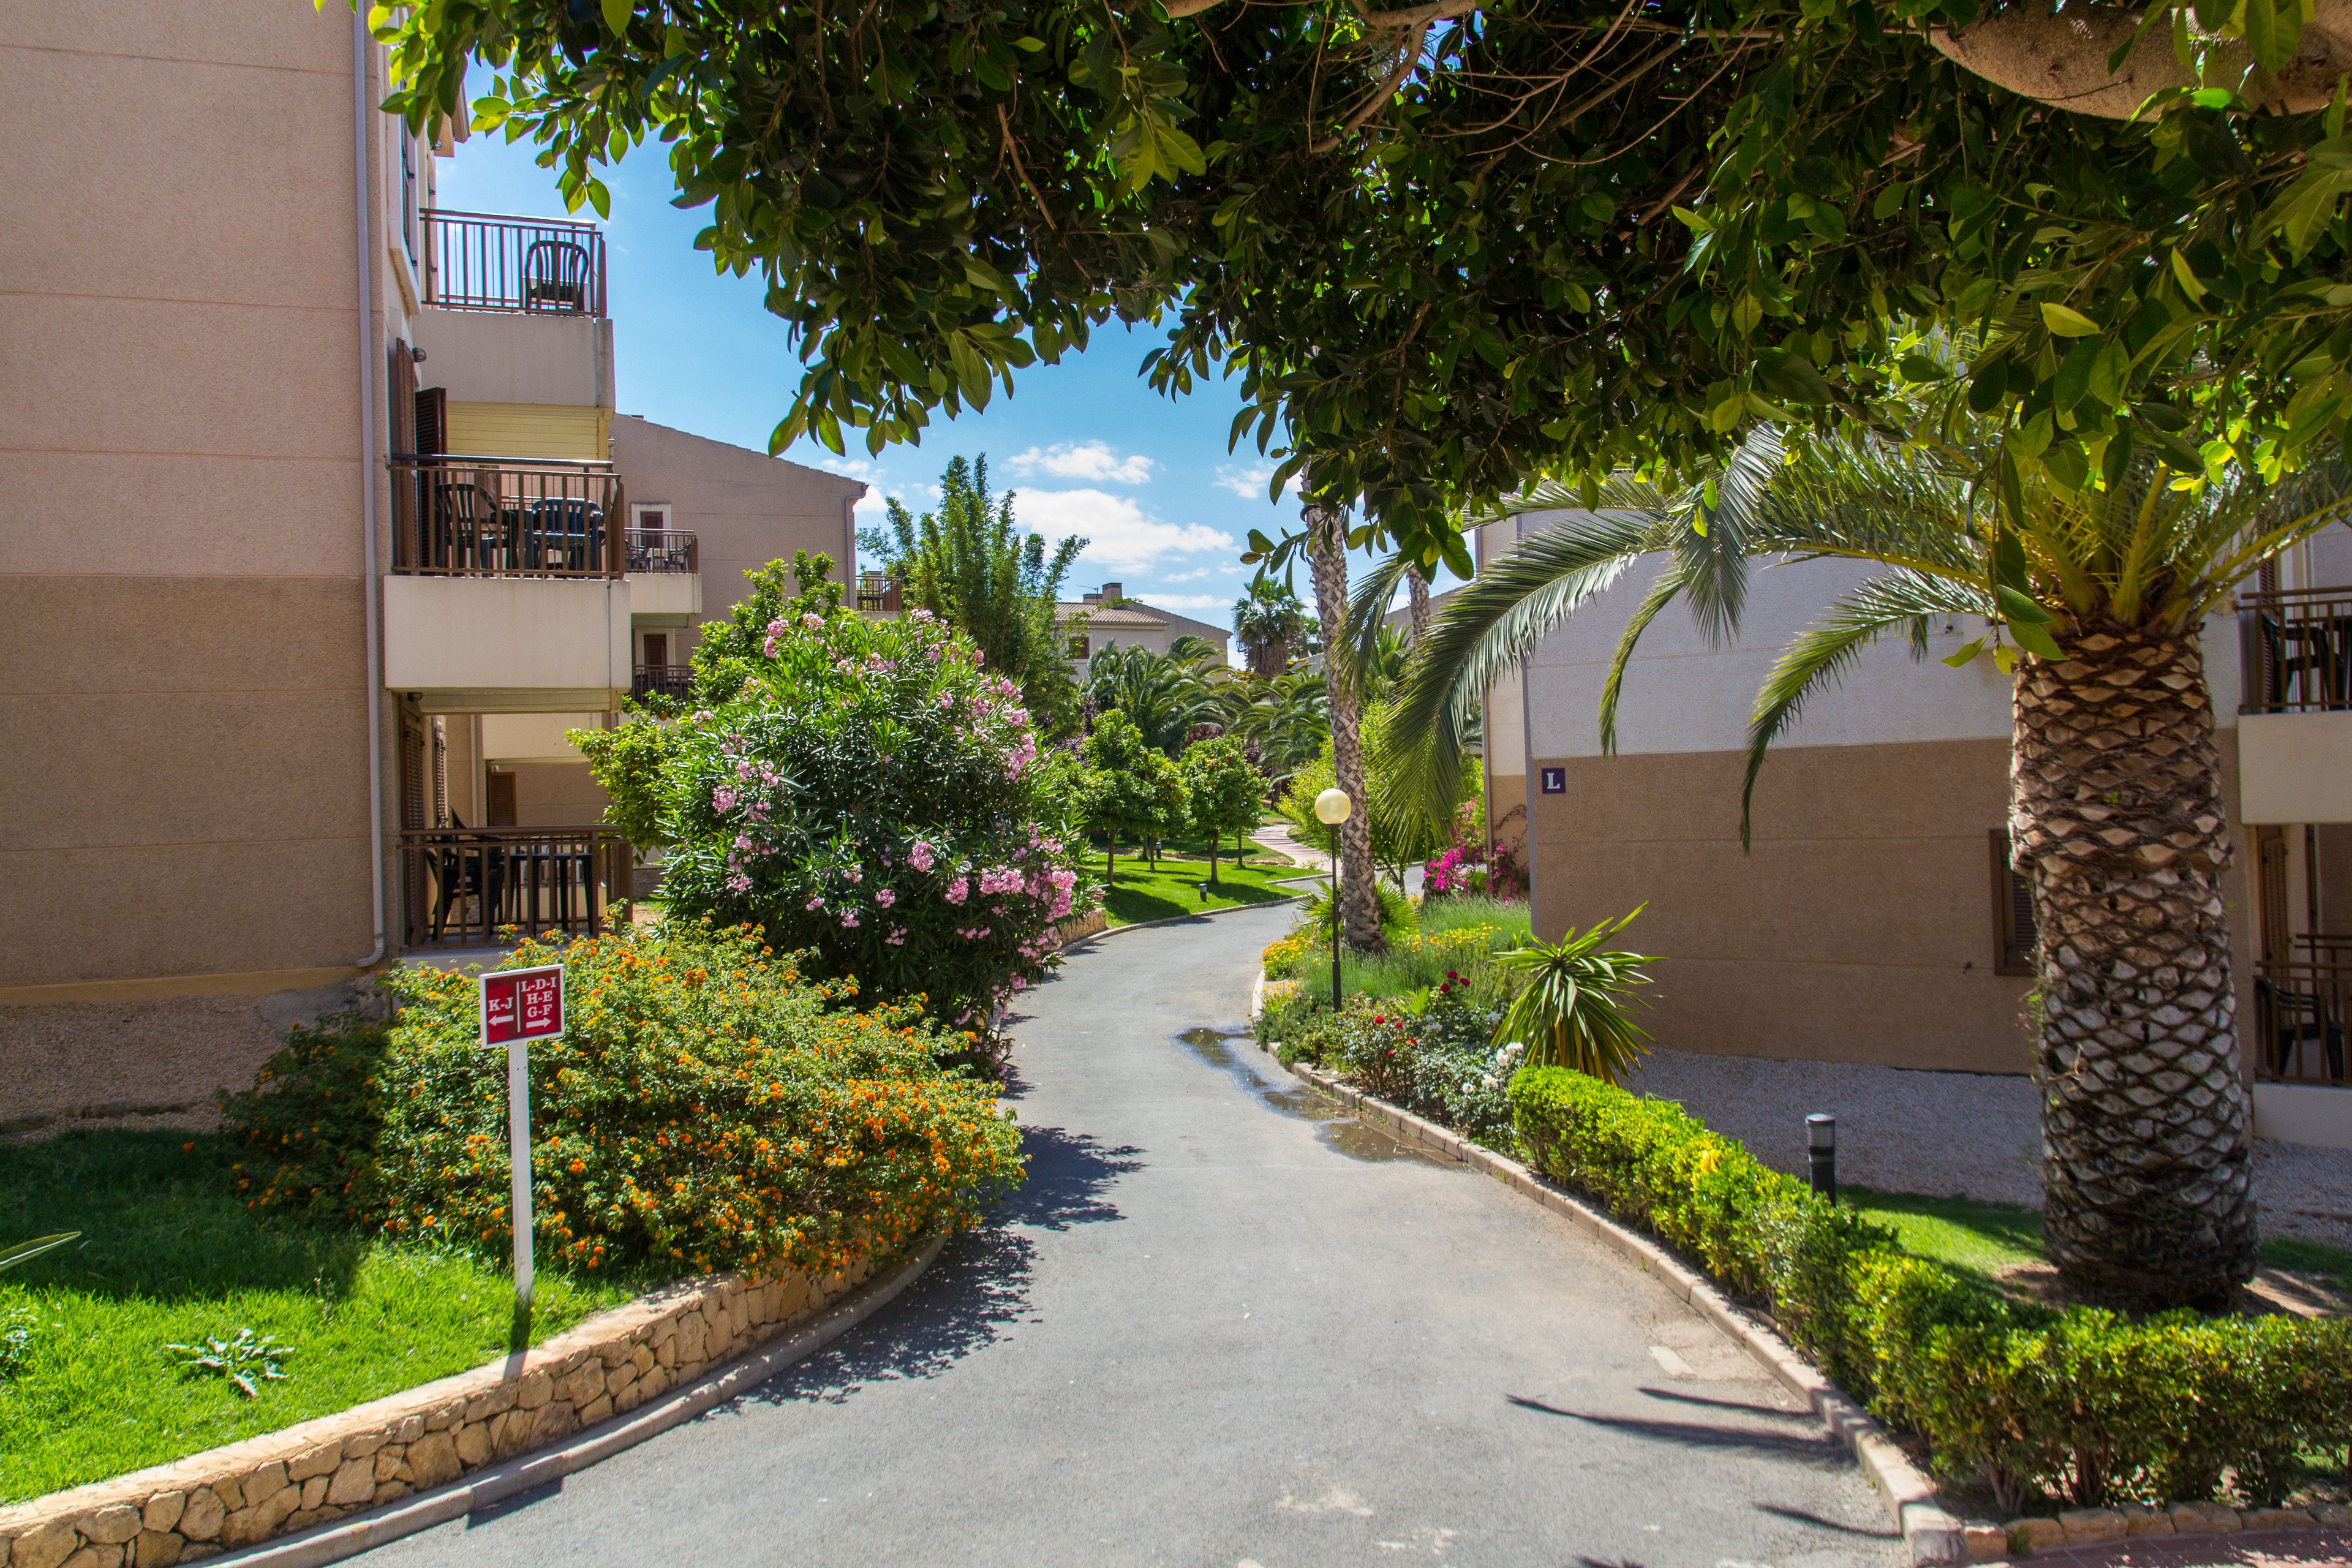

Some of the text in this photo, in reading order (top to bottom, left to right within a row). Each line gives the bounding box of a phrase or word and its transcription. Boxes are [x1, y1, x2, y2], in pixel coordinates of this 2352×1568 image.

[1547, 772, 1560, 789] L
[521, 977, 557, 992] L-D-I
[488, 997, 513, 1012] K-J
[526, 990, 552, 1005] H-E
[527, 1004, 552, 1018] G-F
